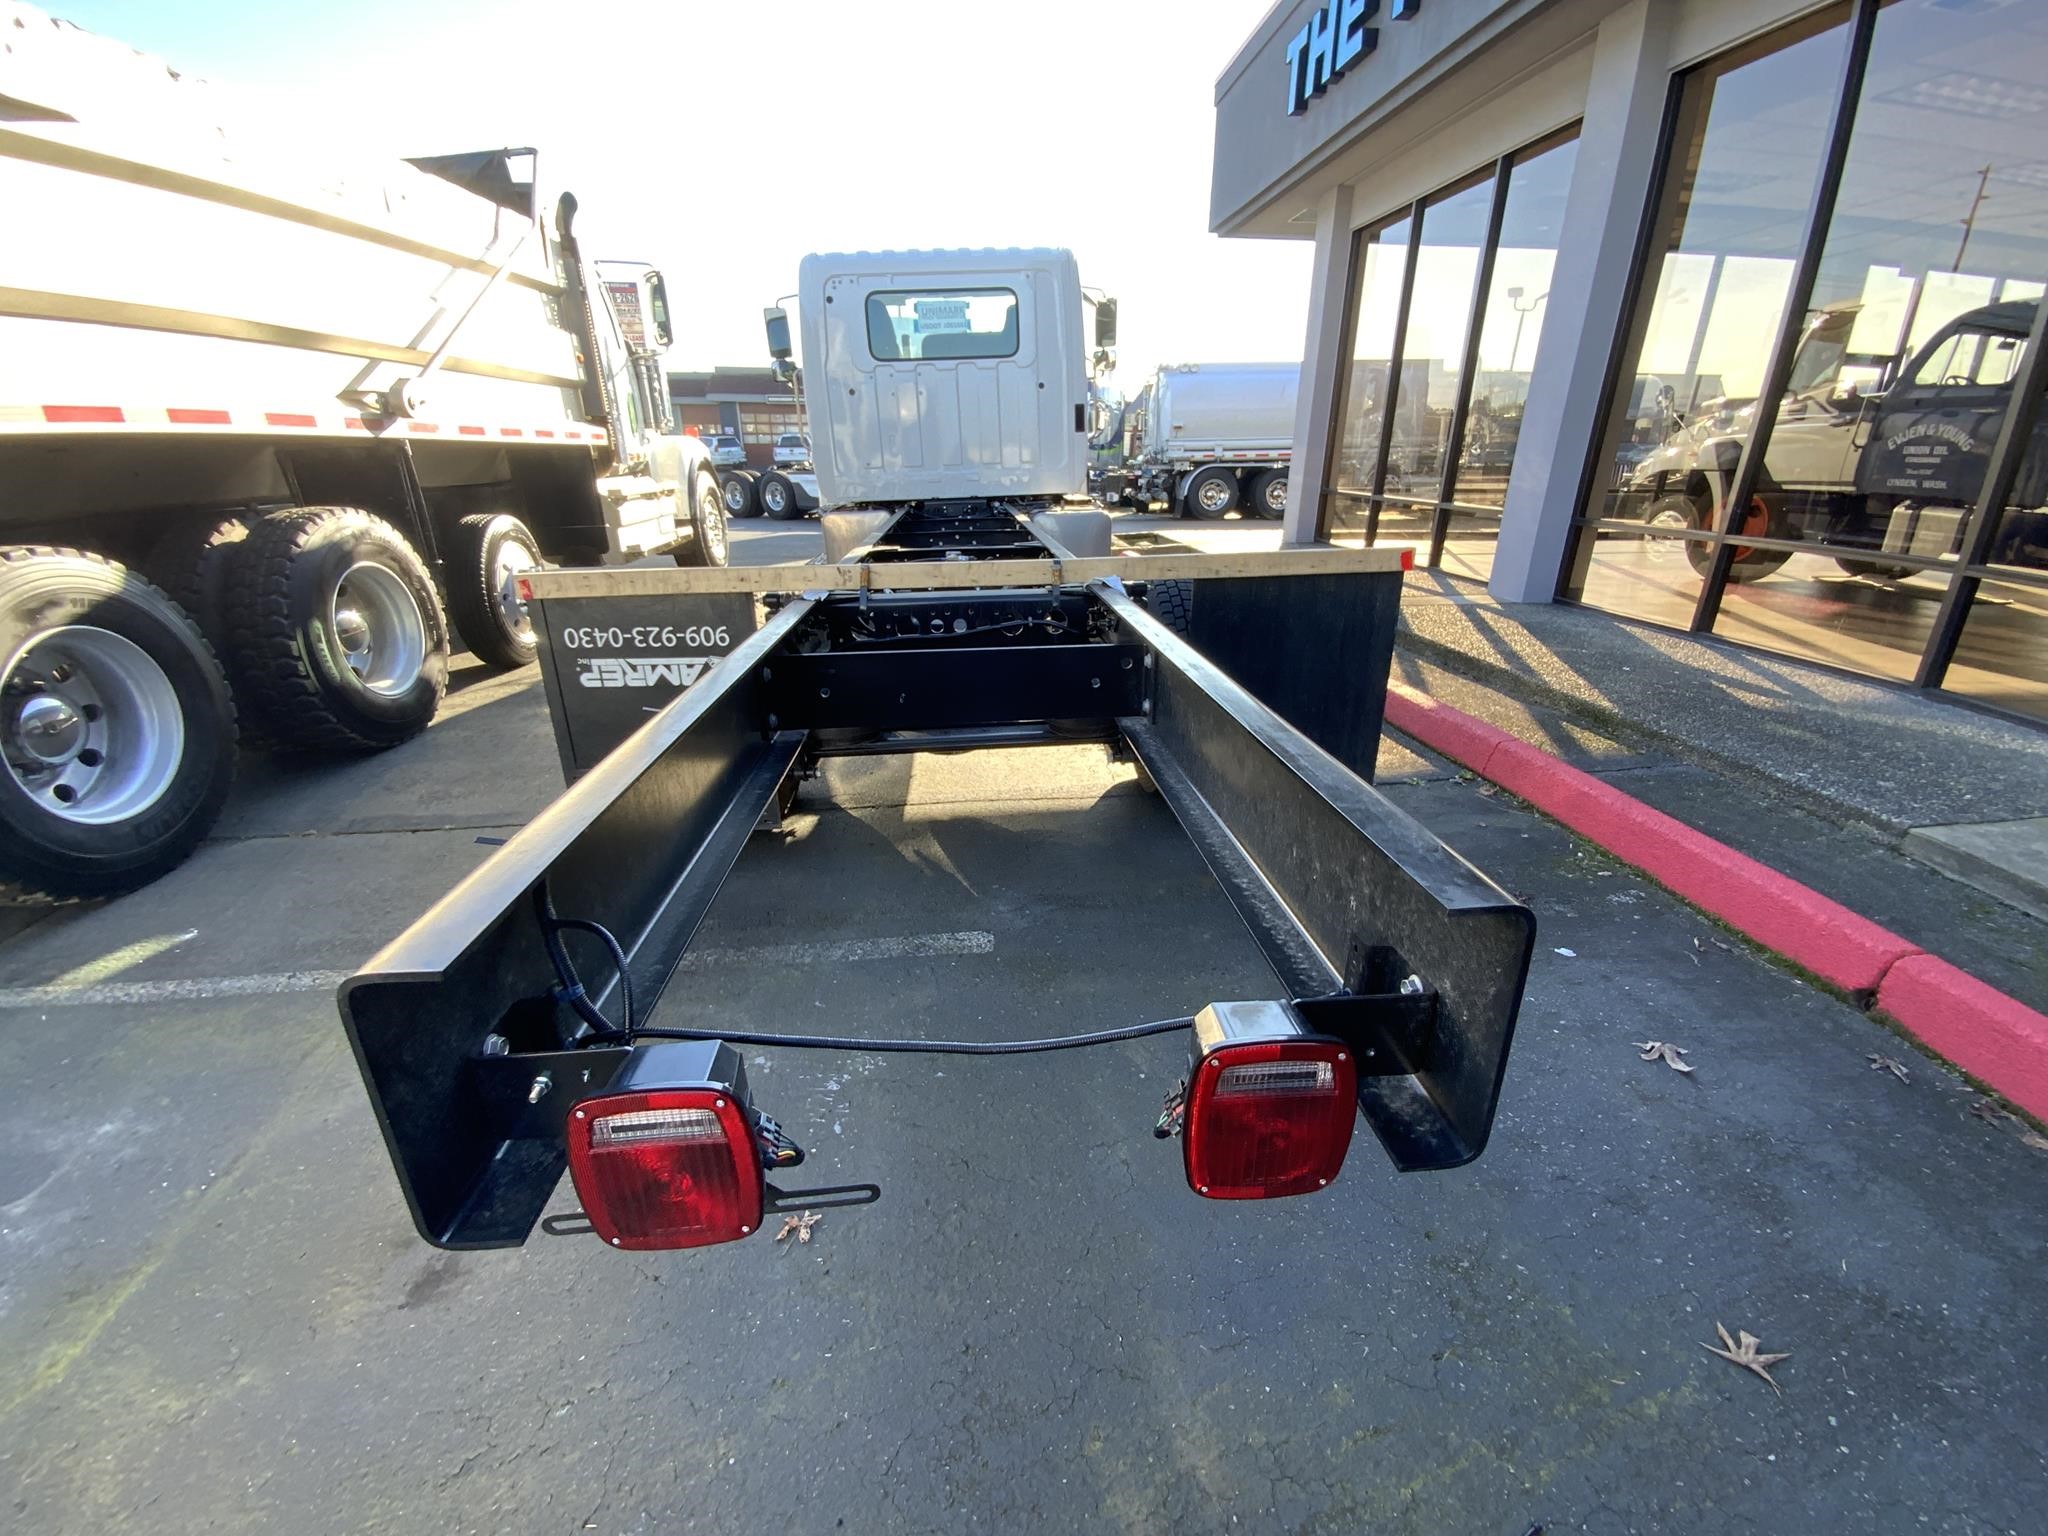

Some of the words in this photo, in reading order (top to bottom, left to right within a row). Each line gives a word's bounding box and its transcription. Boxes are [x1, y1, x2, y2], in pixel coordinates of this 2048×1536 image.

[1286, 0, 1378, 116] THE
[1926, 423, 1936, 436] &
[1936, 424, 1975, 452] YOUNG
[564, 625, 730, 649] 909-923-0430
[579, 657, 706, 688] AMREP
